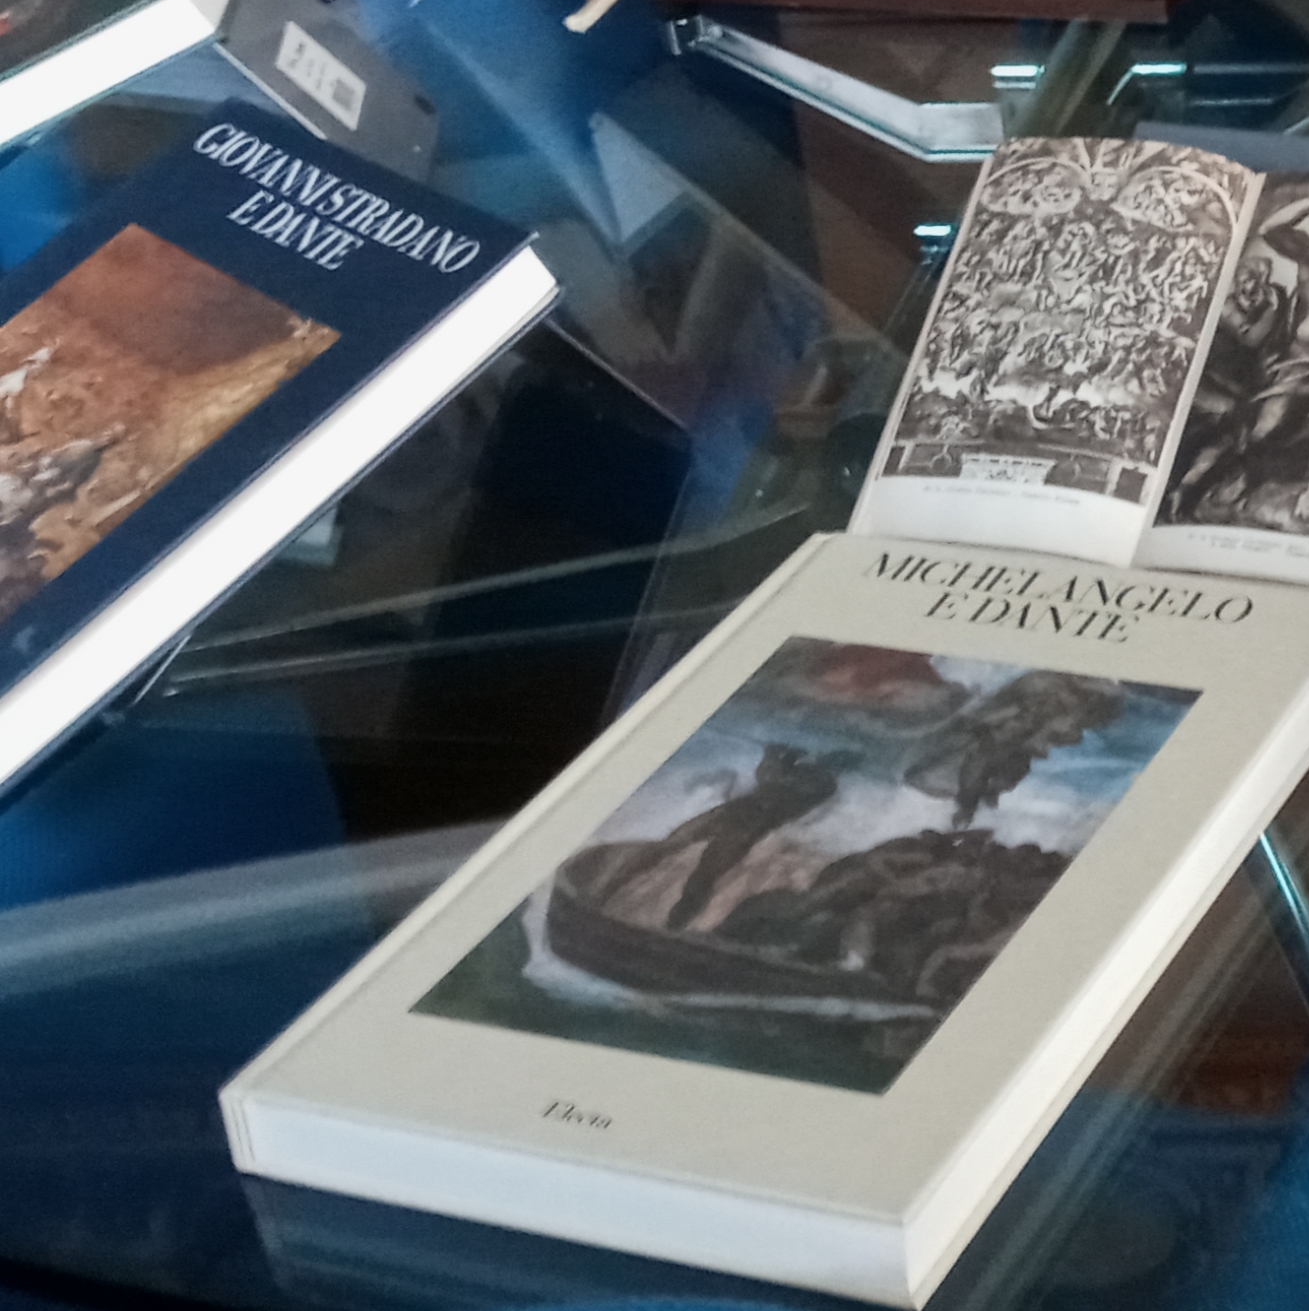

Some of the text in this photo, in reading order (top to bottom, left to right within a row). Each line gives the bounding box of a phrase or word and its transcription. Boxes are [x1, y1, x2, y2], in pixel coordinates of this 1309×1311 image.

[192, 123, 481, 273] GIOVANNI STRADANO
[226, 189, 365, 271] E DANTE
[863, 552, 1255, 624] MICHELANGELO
[923, 591, 1140, 644] E DANTE
